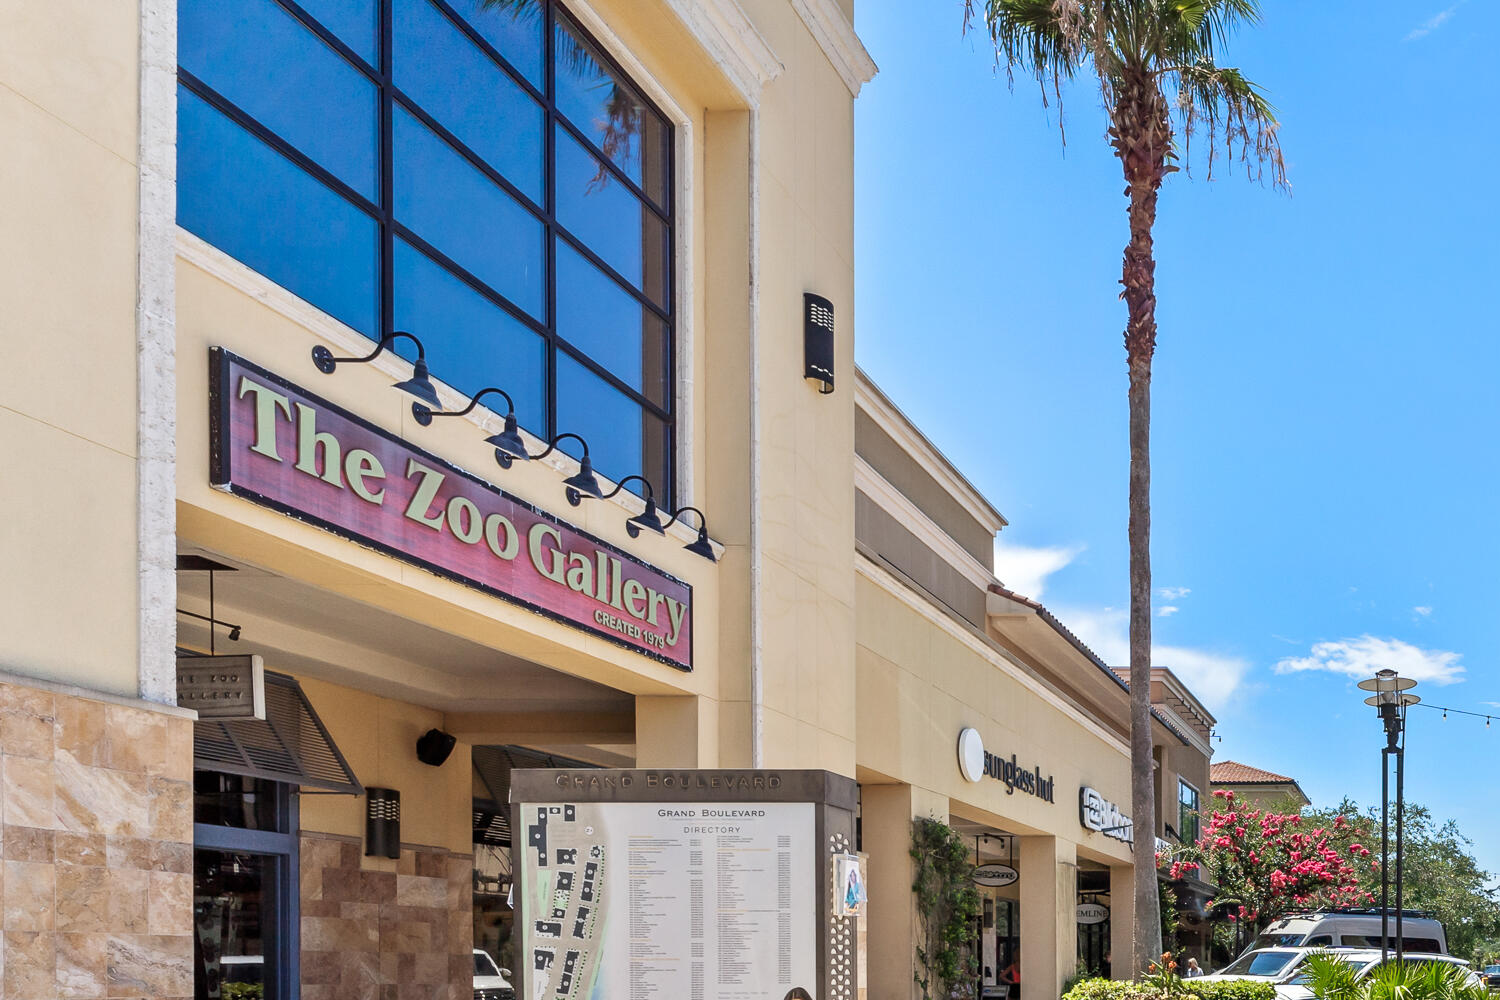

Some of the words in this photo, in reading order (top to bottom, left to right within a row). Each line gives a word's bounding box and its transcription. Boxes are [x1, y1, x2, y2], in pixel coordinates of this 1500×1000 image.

[238, 375, 387, 505] The
[405, 458, 519, 561] Zoo
[528, 523, 688, 646] Gallery
[594, 610, 641, 639] CREATED
[643, 630, 665, 649] 1979
[211, 674, 240, 683] ZOO
[178, 691, 244, 700] ALLERY
[556, 774, 634, 788] GRAND
[647, 774, 782, 789] BOULEVARD
[982, 750, 1034, 796] sunglass
[1034, 766, 1055, 804] hut
[658, 809, 696, 818] GRAND
[701, 809, 766, 818] BOULEVARD
[683, 826, 742, 834] DIRECTORY
[1076, 910, 1108, 918] EMLINE
